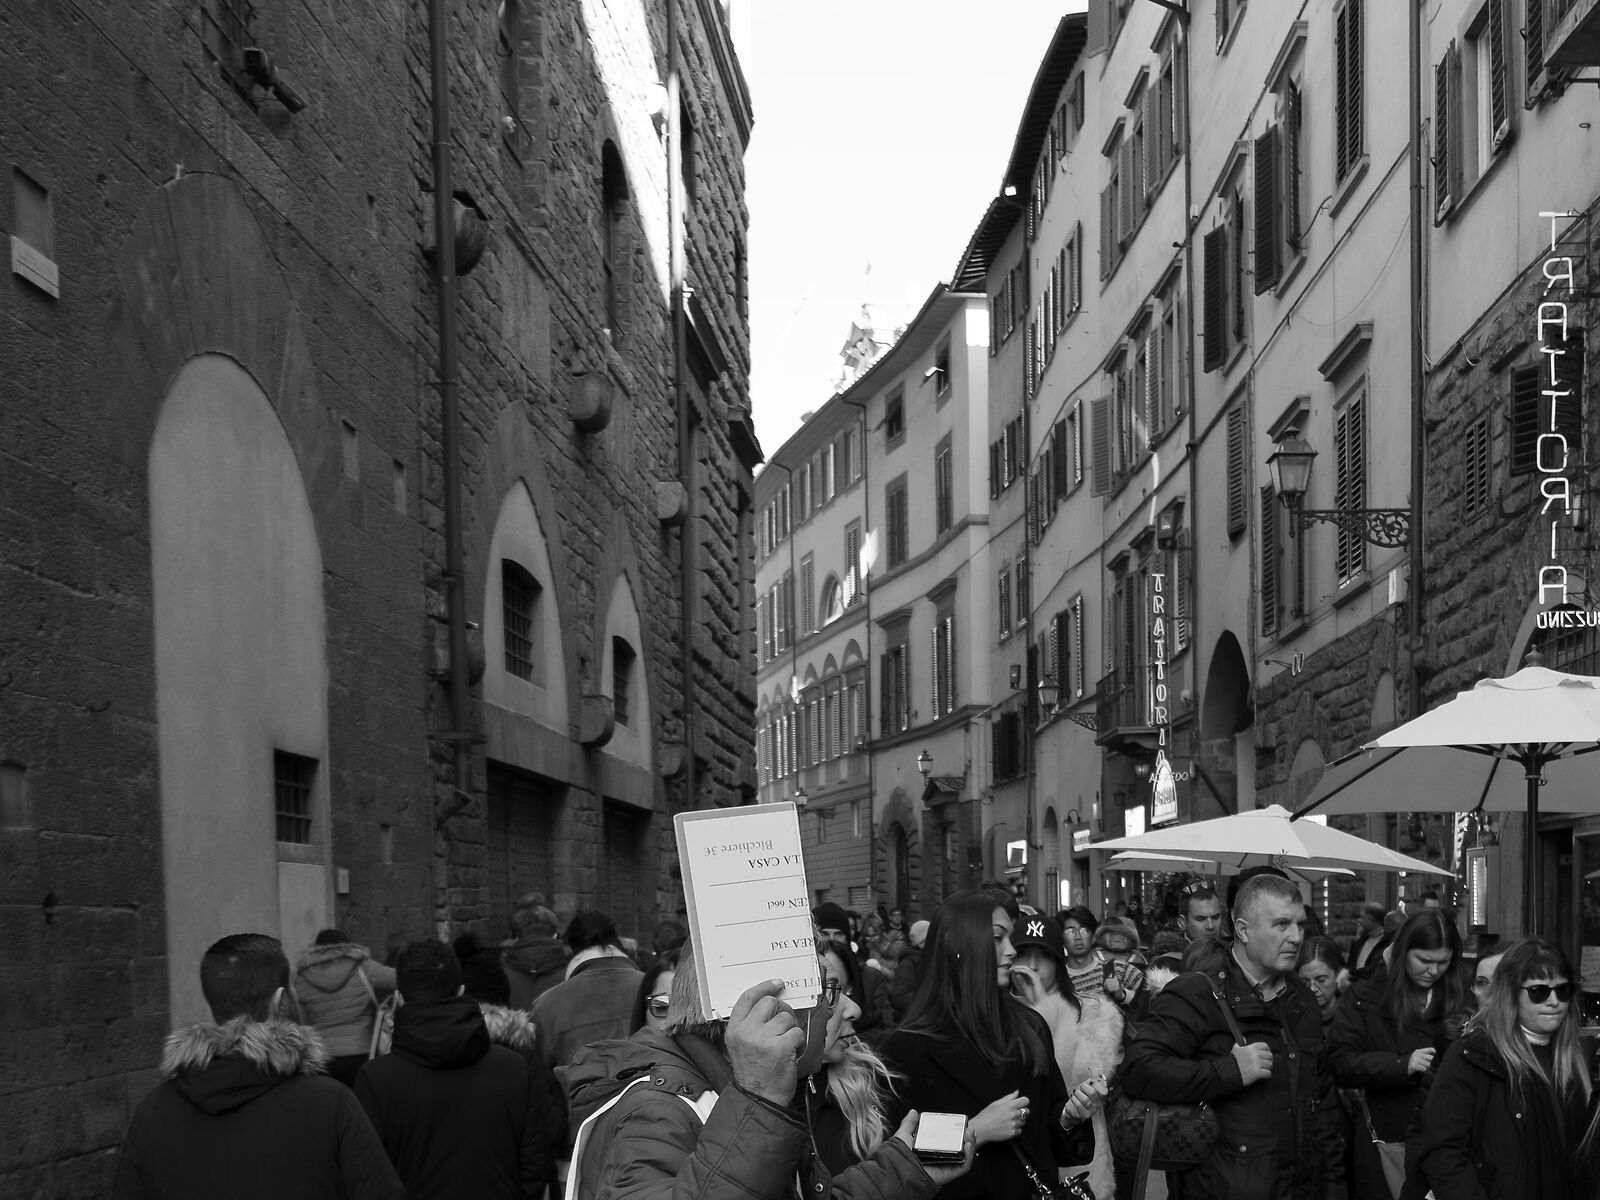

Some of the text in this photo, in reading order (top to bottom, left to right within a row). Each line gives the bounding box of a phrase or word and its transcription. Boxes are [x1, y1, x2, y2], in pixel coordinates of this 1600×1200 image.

[1151, 573, 1168, 767] TRATTORIA
[721, 840, 774, 854] Bicchiere
[748, 854, 801, 869] LA CASA
[767, 899, 785, 910] 66cl
[1026, 920, 1045, 938] NY
[771, 940, 789, 950] 33cl
